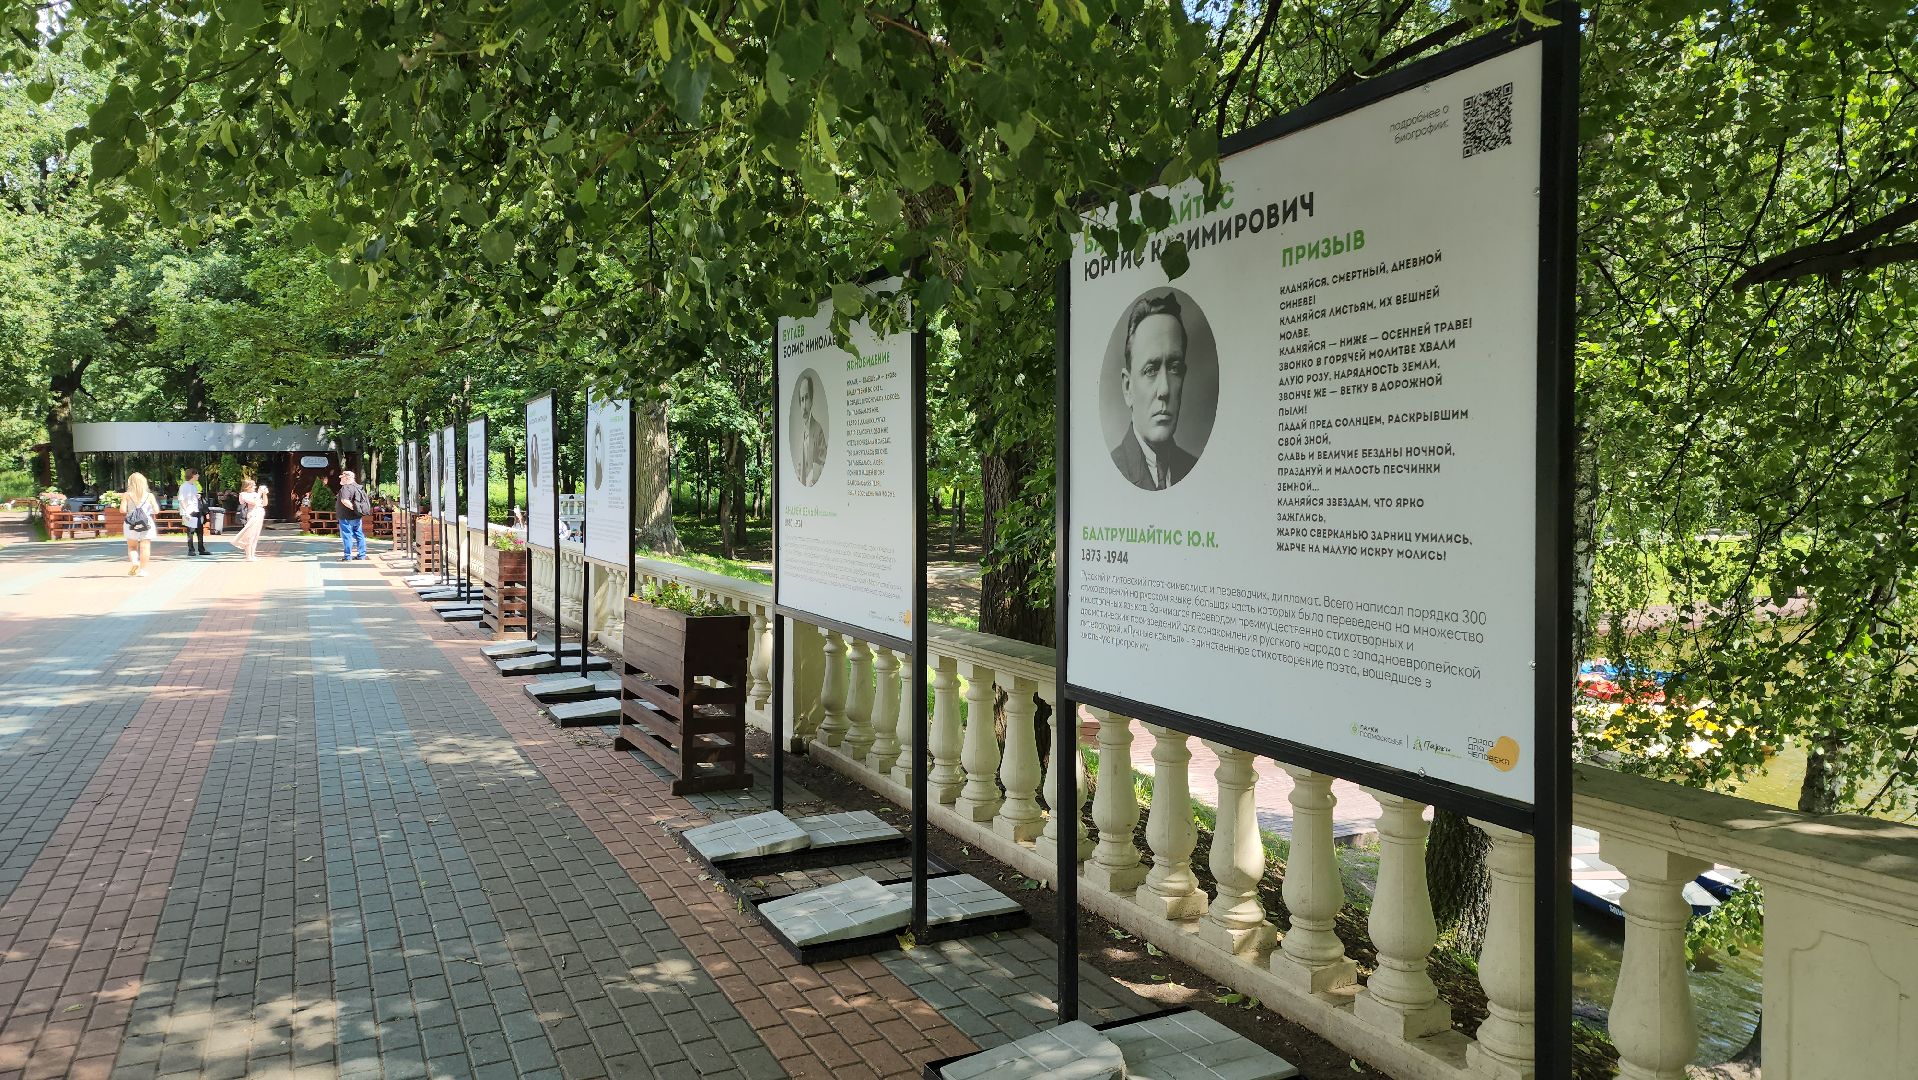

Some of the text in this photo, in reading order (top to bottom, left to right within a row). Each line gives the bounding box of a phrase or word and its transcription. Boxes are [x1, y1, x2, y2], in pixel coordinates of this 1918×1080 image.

[1150, 191, 1314, 264] КИМИРОВИЧ
[1282, 229, 1365, 267] ПРИЗЫВ
[1391, 249, 1442, 273] ДНЕВНОЙ
[1280, 309, 1326, 326] КЛАНЯЙСЯ
[1379, 295, 1393, 307] ИХ
[1395, 285, 1440, 305] ВЕШНЕЙ
[783, 324, 805, 341] БУГАЕВ
[1279, 339, 1326, 356] КЛАНЯЙСЯ
[1340, 334, 1367, 347] НИЖЕ
[1381, 322, 1431, 341] ОСЕННЕЙ
[1434, 317, 1473, 334] ТРАВЕ!
[783, 334, 837, 359] БОРИС НИКОЛАЕ
[1279, 339, 1456, 371] ЗВОНКО В ГОРЯЧЕЙ МОЛИТВЕ ХВАЛИ
[1279, 374, 1304, 386] АЛУЮ
[1334, 363, 1399, 380] НАРЯДНОСТЬ
[1278, 390, 1311, 402] ЗВОНЧЕ
[1313, 388, 1327, 398] ЖЕ
[1340, 383, 1368, 396] ВЕТКУ
[1372, 382, 1378, 393] В
[1380, 372, 1443, 392] ДОРОЖНОЙ
[1278, 405, 1308, 417] ПЫЛИ!
[1278, 417, 1307, 432] ПАДАЙ
[1309, 418, 1333, 429] ПРЕД
[1388, 408, 1469, 424] РАСКРЫВШИМ
[1277, 443, 1455, 462] СЛАВЬ И ВЕЛИЧИЕ БЕЗДНЫ НОЧНОЙ,
[1278, 435, 1302, 447] СВОЙ
[1277, 463, 1441, 477] ПРАЗДНУЙ И МАЛОСТЬ ПЕСЧИНКИ
[1277, 495, 1324, 506] КЛАНЯЙСЯ
[1374, 497, 1393, 507] ЧТО
[1395, 497, 1424, 508] ЯРКО
[1082, 524, 1219, 548] БАЛТРУШАЙТИС Ю.К.
[1276, 527, 1308, 538] ЖАРКО
[1309, 528, 1369, 540] СВЕРКАНЬЮ
[1370, 530, 1412, 542] ЗАРНИЦ
[1081, 548, 1101, 562] 1873
[1276, 541, 1447, 561] ЖАРЧЕ НА МАЛУЮ ИСКРУ МОЛИСЬ!
[1209, 586, 1215, 595] и
[1323, 595, 1354, 611] Всего
[1355, 602, 1404, 616] написал
[1407, 606, 1459, 622] порядка
[1462, 609, 1487, 625] 300
[1191, 610, 1237, 625] переводом
[1239, 617, 1324, 637] преимущественно
[1326, 629, 1404, 651] стихотворных
[1406, 642, 1414, 651] и
[1194, 595, 1229, 611] большая
[1231, 603, 1256, 613] часть
[1257, 606, 1296, 619] которых
[1298, 608, 1324, 622] была
[1326, 613, 1392, 631] переведена
[1395, 623, 1410, 634] на
[1413, 625, 1484, 643] множество
[1182, 623, 1195, 633] для
[1197, 625, 1257, 642] ознакомления
[1259, 634, 1300, 650] русского
[1302, 642, 1341, 658] народа
[1344, 649, 1350, 658] с
[1352, 650, 1481, 680] западноевропейской
[1251, 647, 1324, 669] стихотворение
[1326, 660, 1360, 677] поэта,
[1362, 665, 1422, 687] вошедшее
[1467, 750, 1510, 766] ЧЕЛОВЕКА
